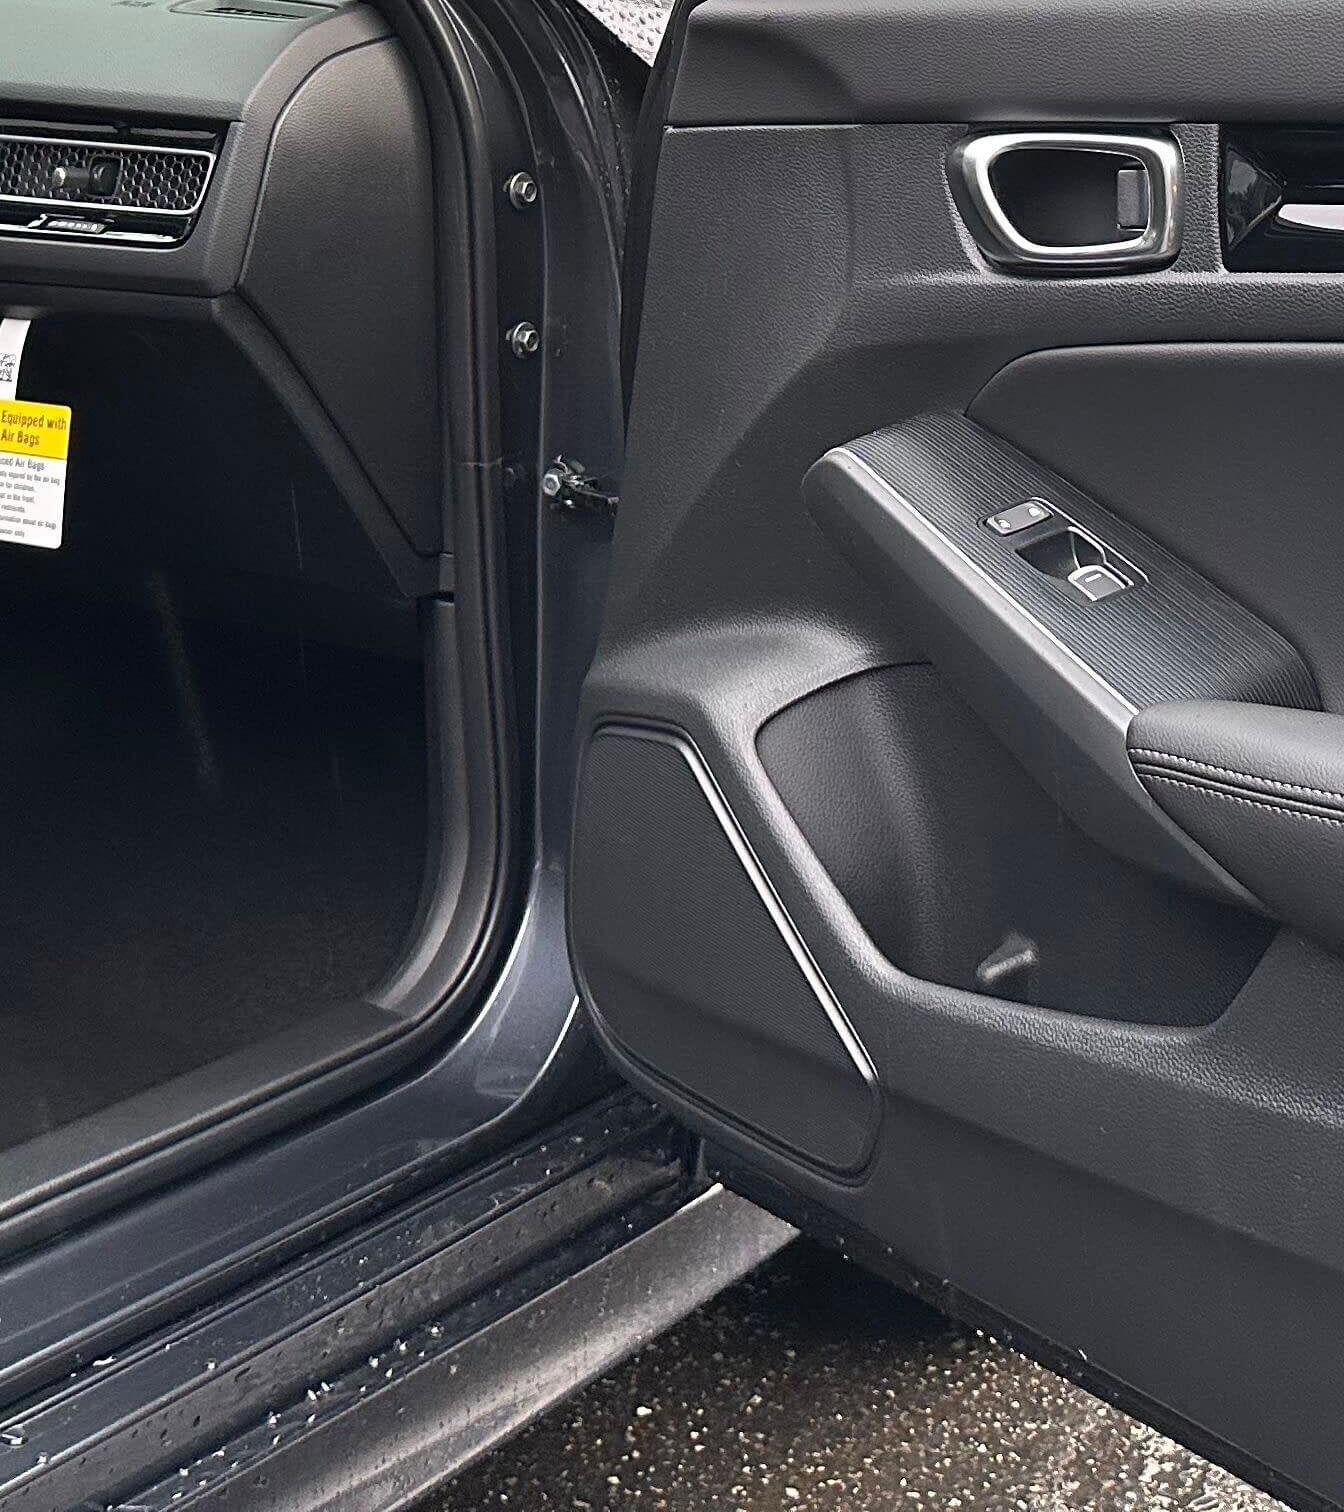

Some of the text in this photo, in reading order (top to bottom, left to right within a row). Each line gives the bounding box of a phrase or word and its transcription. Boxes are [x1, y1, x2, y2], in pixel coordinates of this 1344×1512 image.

[1, 409, 45, 430] Equipped
[47, 417, 67, 430] with
[0, 428, 15, 442] Air
[17, 430, 41, 448] Bags
[15, 457, 26, 468] Air
